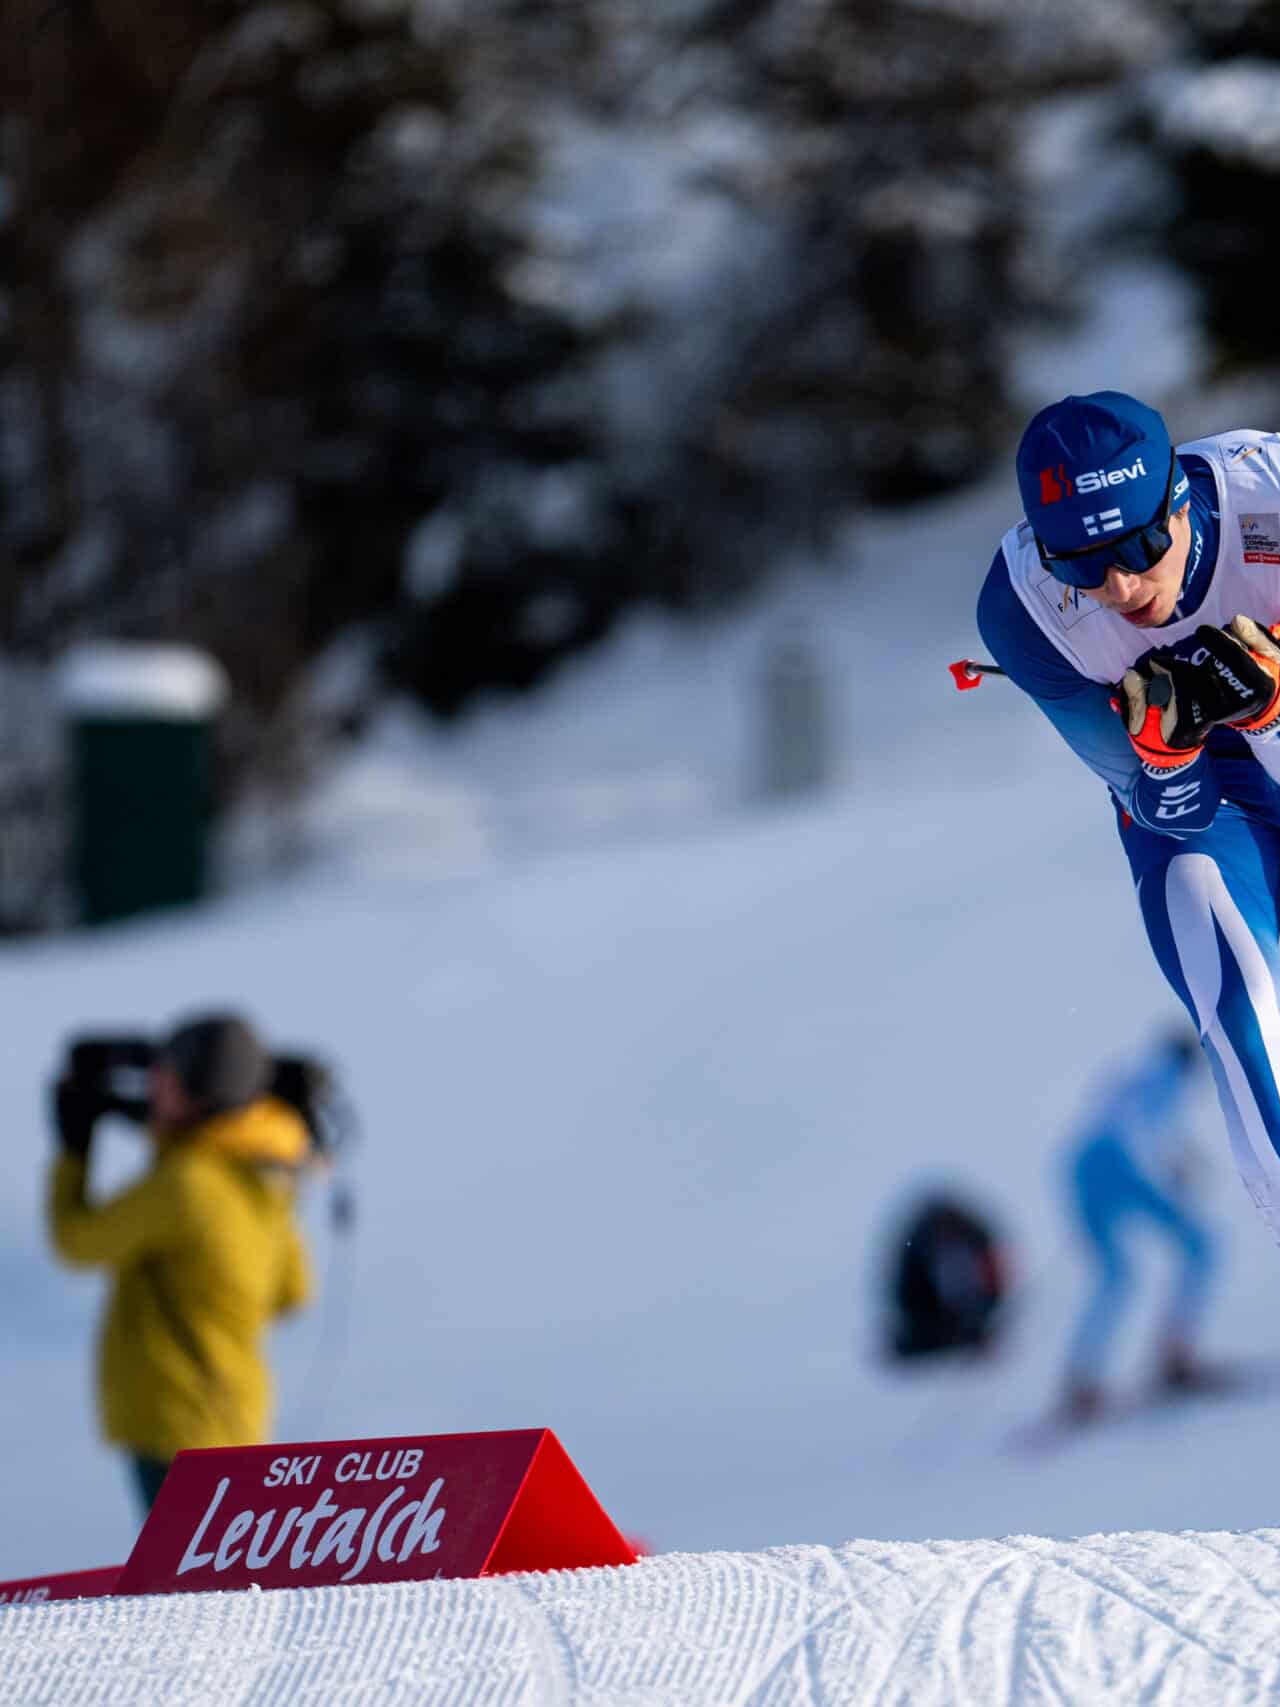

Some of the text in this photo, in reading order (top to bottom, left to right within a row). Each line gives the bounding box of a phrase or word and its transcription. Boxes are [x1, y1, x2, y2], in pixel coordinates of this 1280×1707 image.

[1075, 457, 1147, 495] Sievi
[263, 1449, 424, 1488] SKI CLUB
